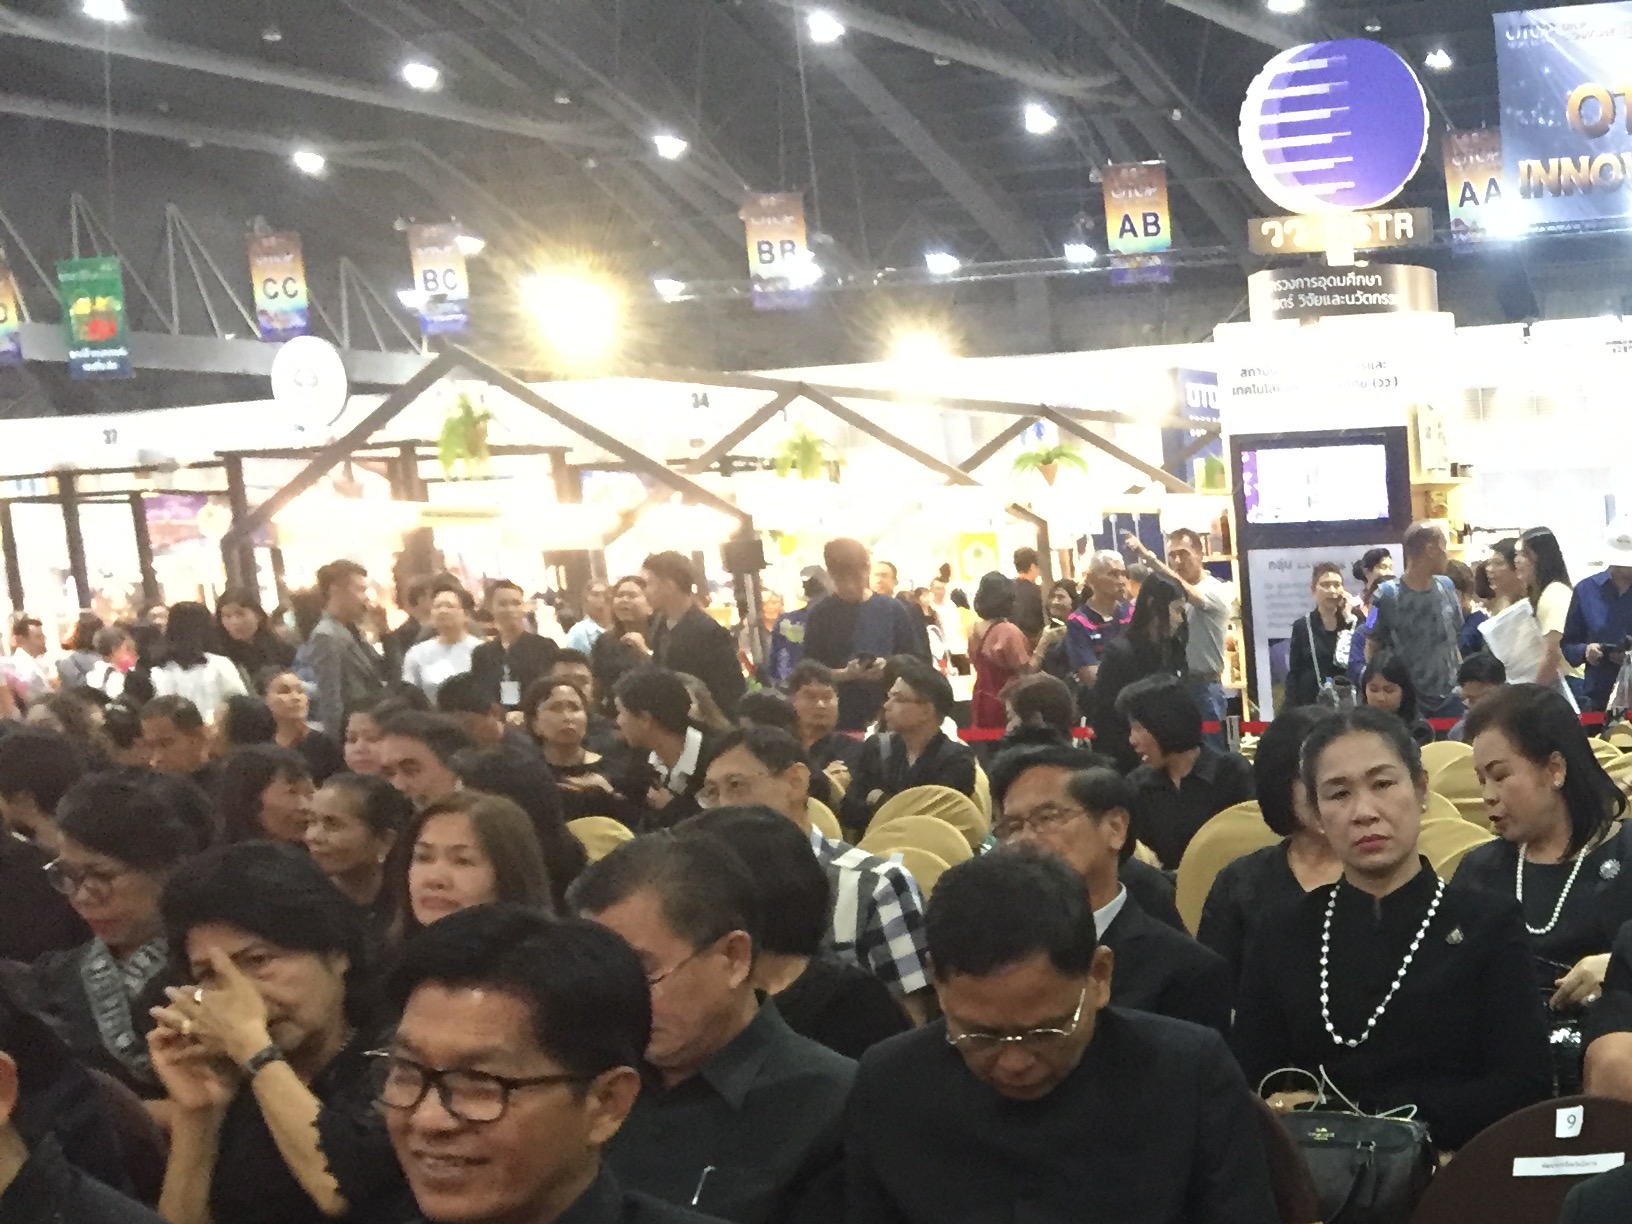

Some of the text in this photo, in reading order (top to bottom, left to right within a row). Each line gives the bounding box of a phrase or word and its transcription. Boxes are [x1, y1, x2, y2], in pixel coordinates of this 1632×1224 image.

[1118, 211, 1162, 240] AB
[261, 276, 299, 300] CC
[421, 267, 459, 293] BC
[1567, 1114, 1577, 1129] 9
